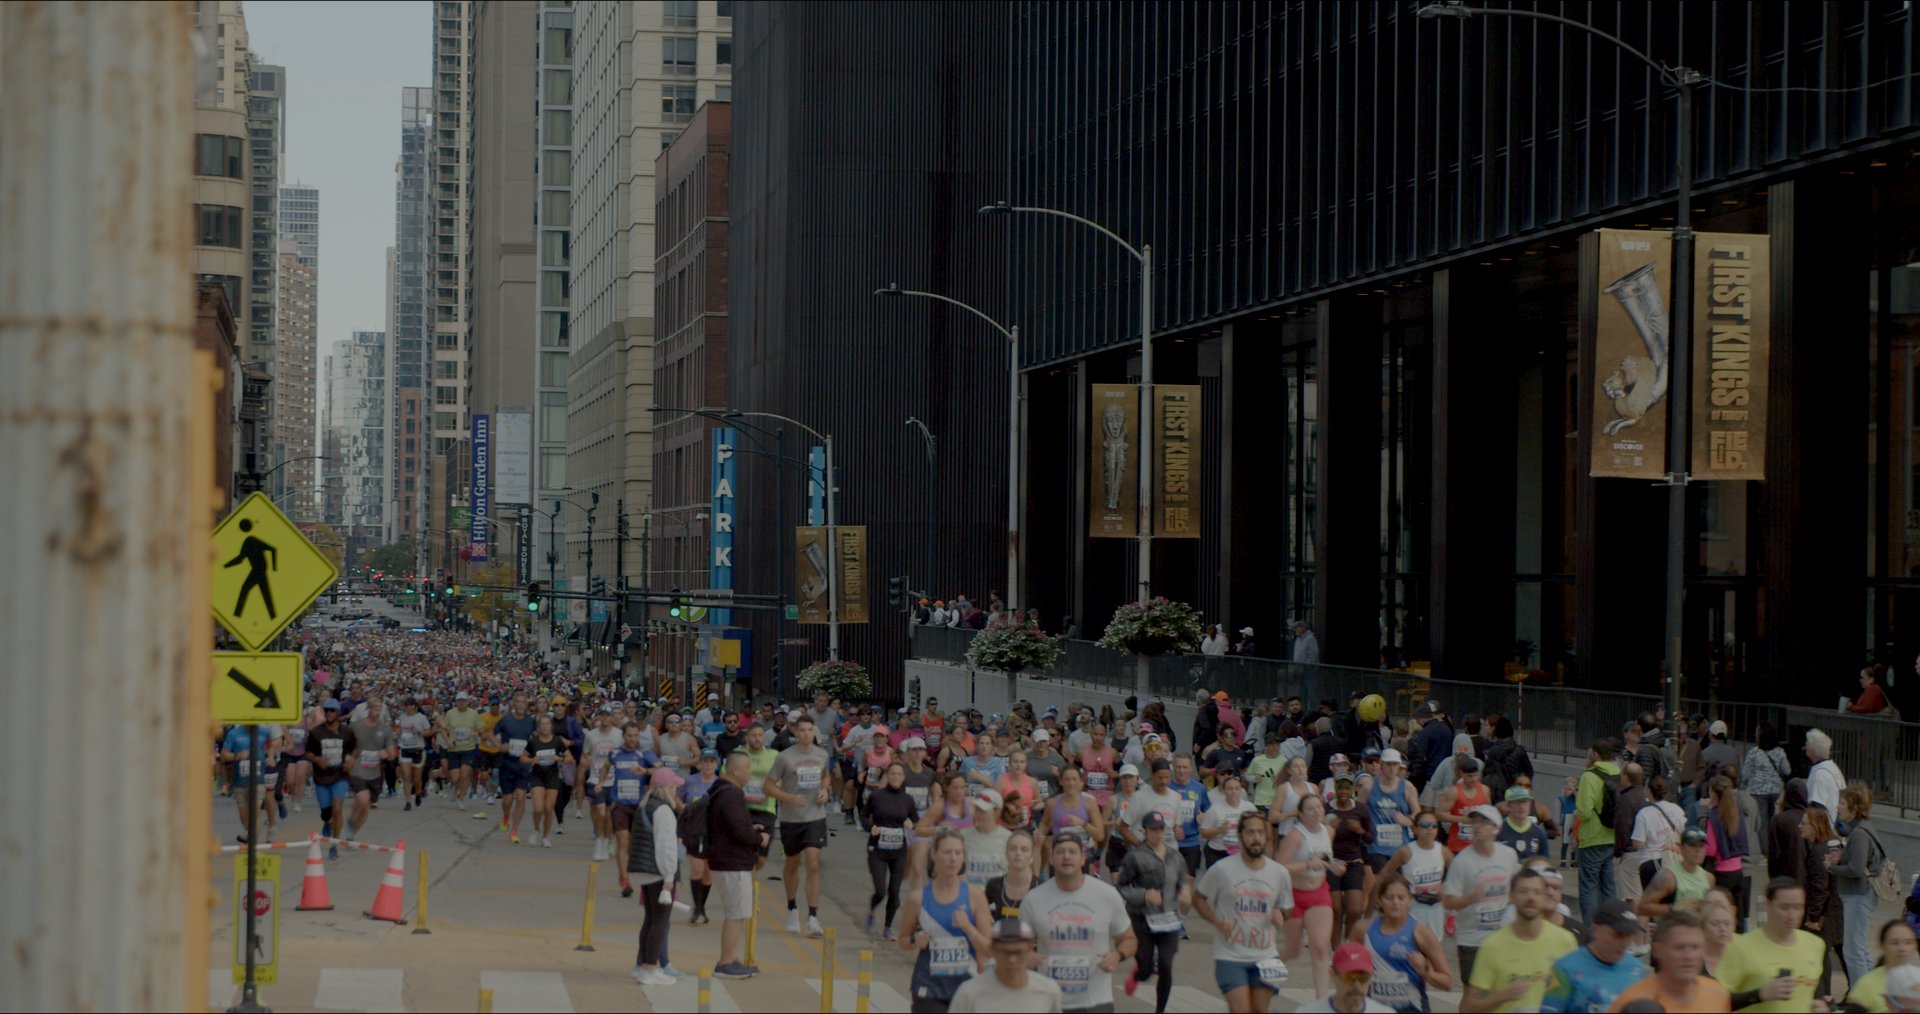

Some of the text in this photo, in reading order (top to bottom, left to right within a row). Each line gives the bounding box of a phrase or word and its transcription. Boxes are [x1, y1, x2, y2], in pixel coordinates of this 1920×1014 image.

[1711, 244, 1752, 320] FIRST
[1711, 324, 1751, 407] KINGS
[473, 419, 488, 541] Hilton Garden Inn
[1164, 391, 1189, 492] FIRST KINGS
[715, 443, 734, 567] PARK
[844, 530, 860, 560] FIRST
[844, 562, 860, 594] KINGS
[243, 896, 271, 910] SOP
